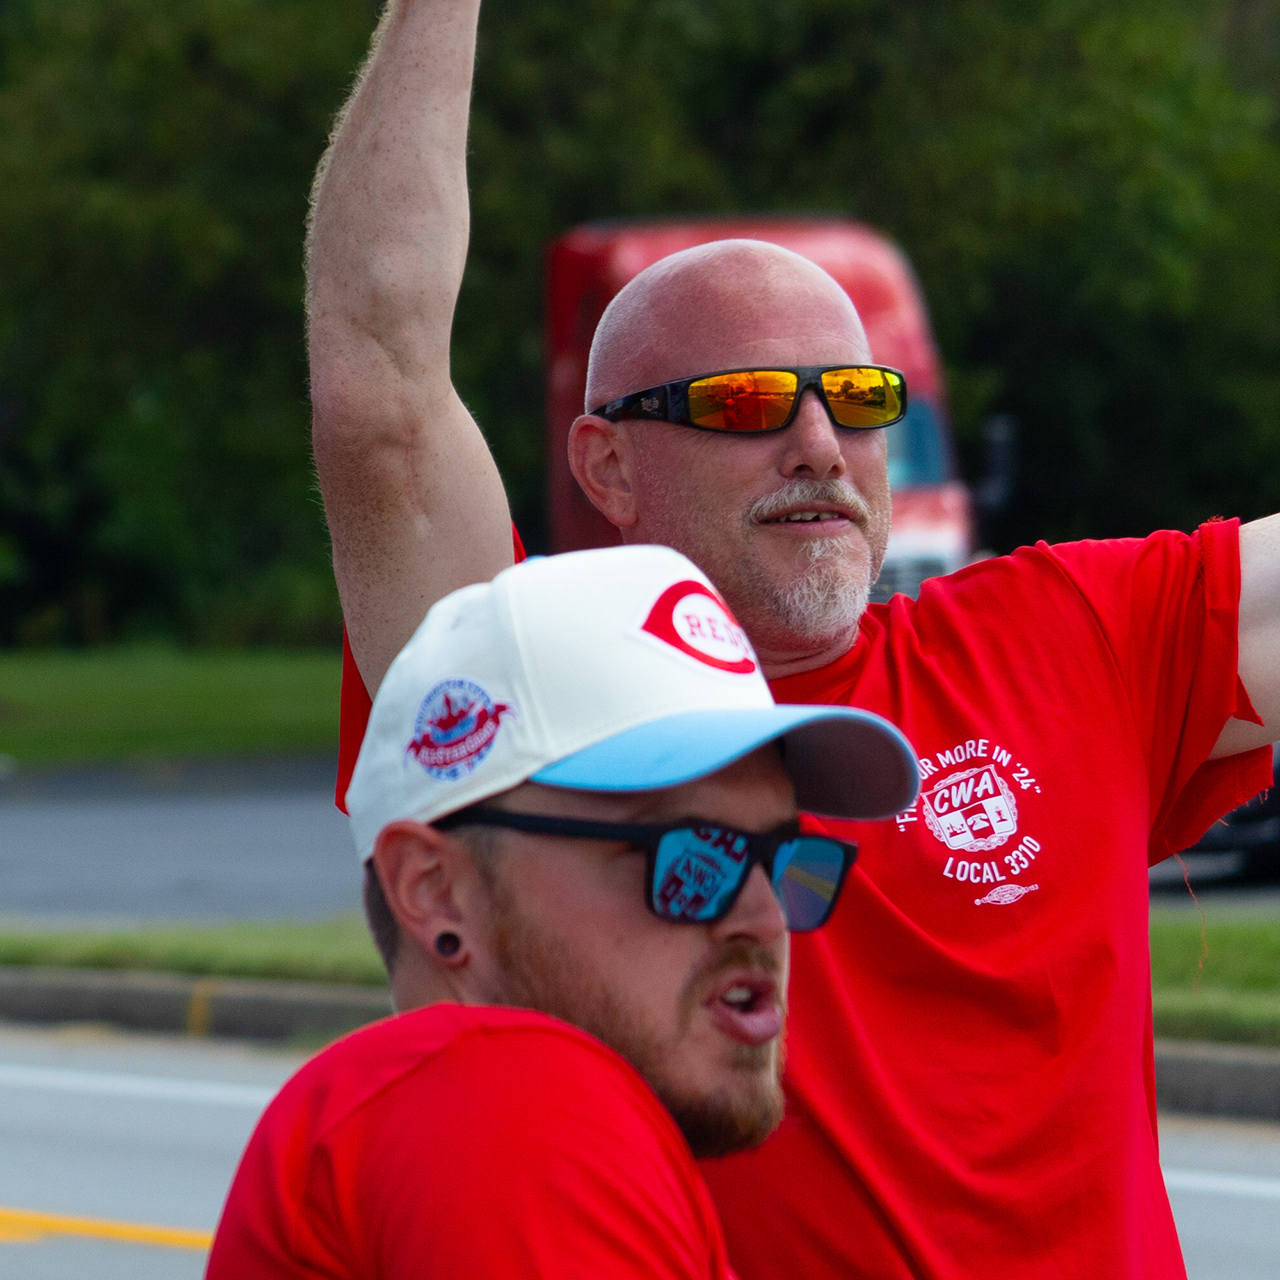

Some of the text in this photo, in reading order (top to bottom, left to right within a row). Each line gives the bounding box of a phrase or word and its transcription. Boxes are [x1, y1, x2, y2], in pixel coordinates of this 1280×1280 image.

[936, 739, 989, 768] MORE
[992, 746, 1012, 767] IN
[934, 771, 994, 813] CWA
[943, 835, 1041, 883] LOCAL 3310
